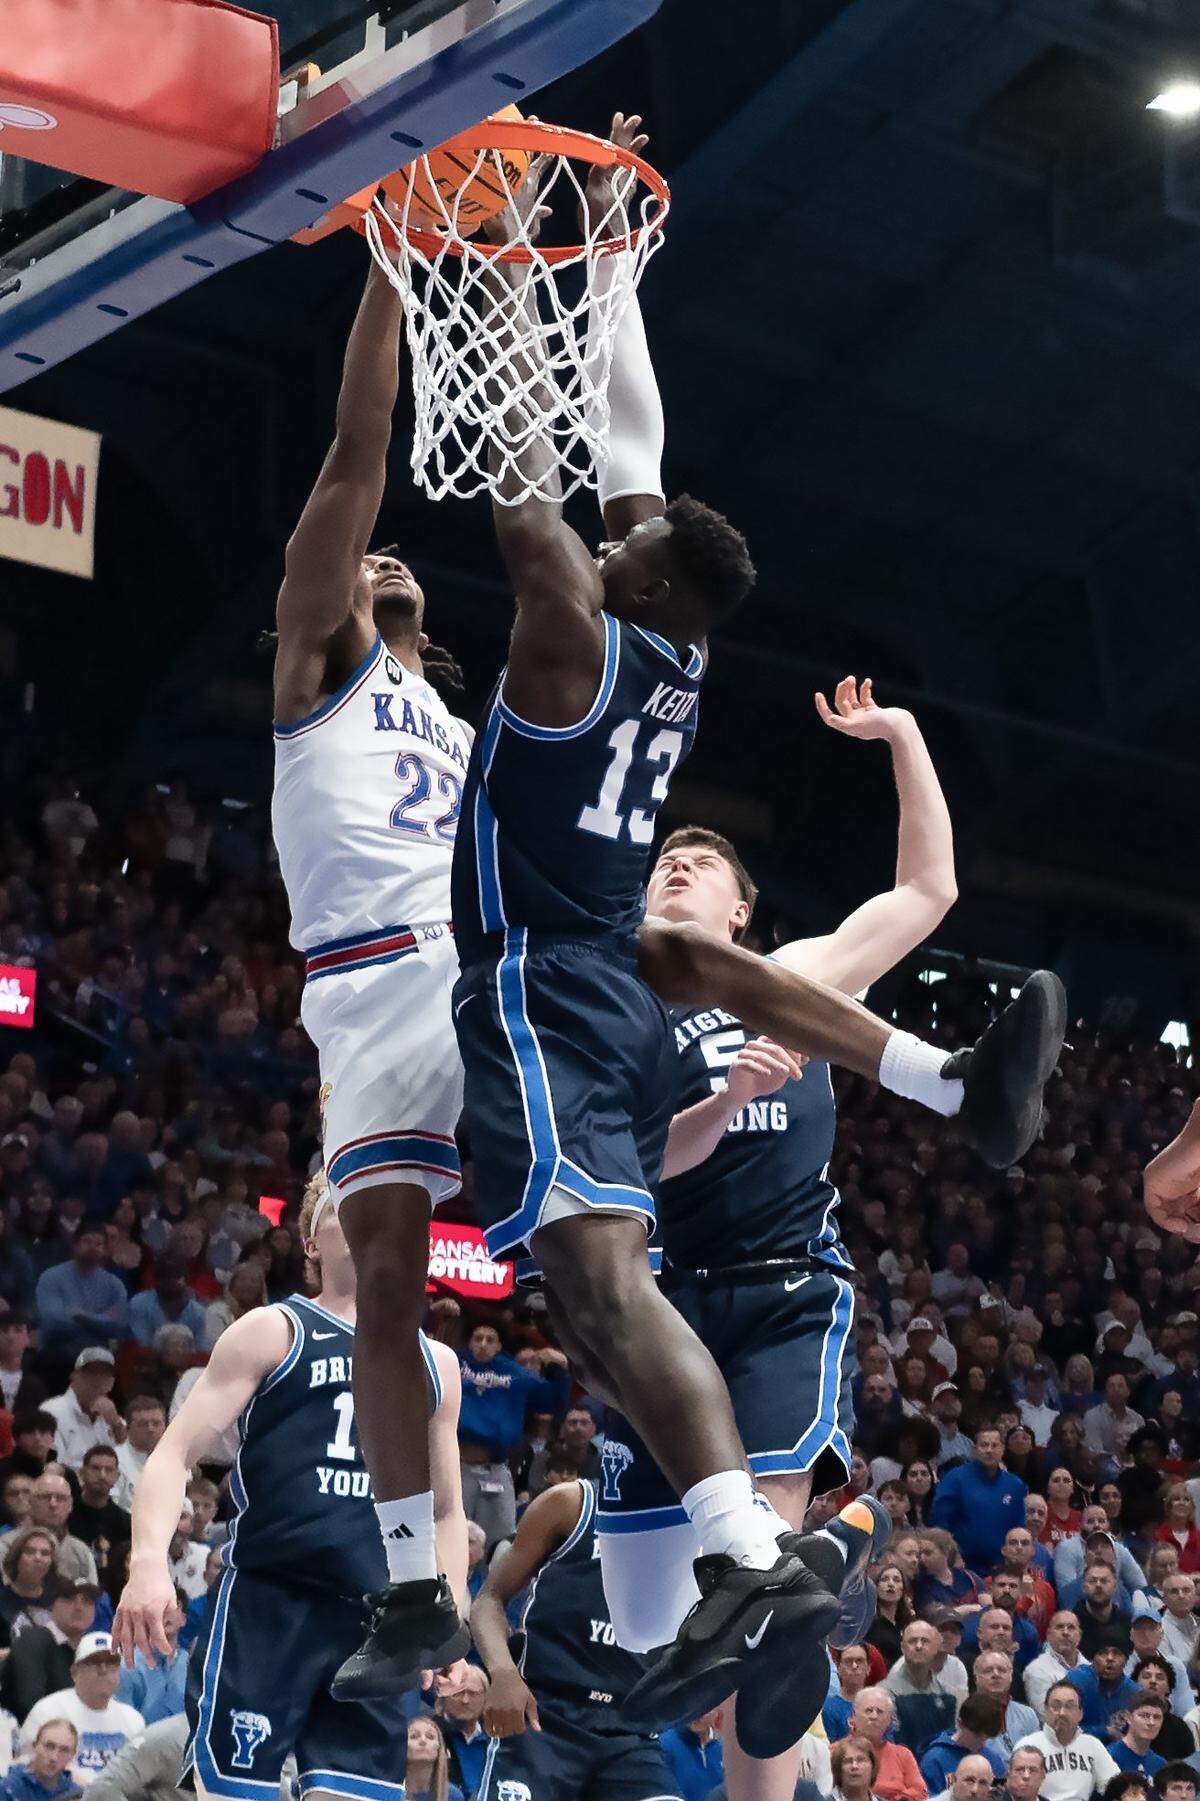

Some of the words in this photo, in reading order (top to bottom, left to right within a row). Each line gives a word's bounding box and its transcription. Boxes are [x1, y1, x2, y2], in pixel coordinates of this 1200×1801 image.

[371, 693, 470, 774] KANSA
[389, 752, 463, 842] 22
[577, 719, 683, 844] 13
[700, 1029, 745, 1093] 5
[727, 1101, 789, 1133] UNG
[428, 1256, 508, 1286] OTTERY
[316, 1466, 375, 1500] YOU
